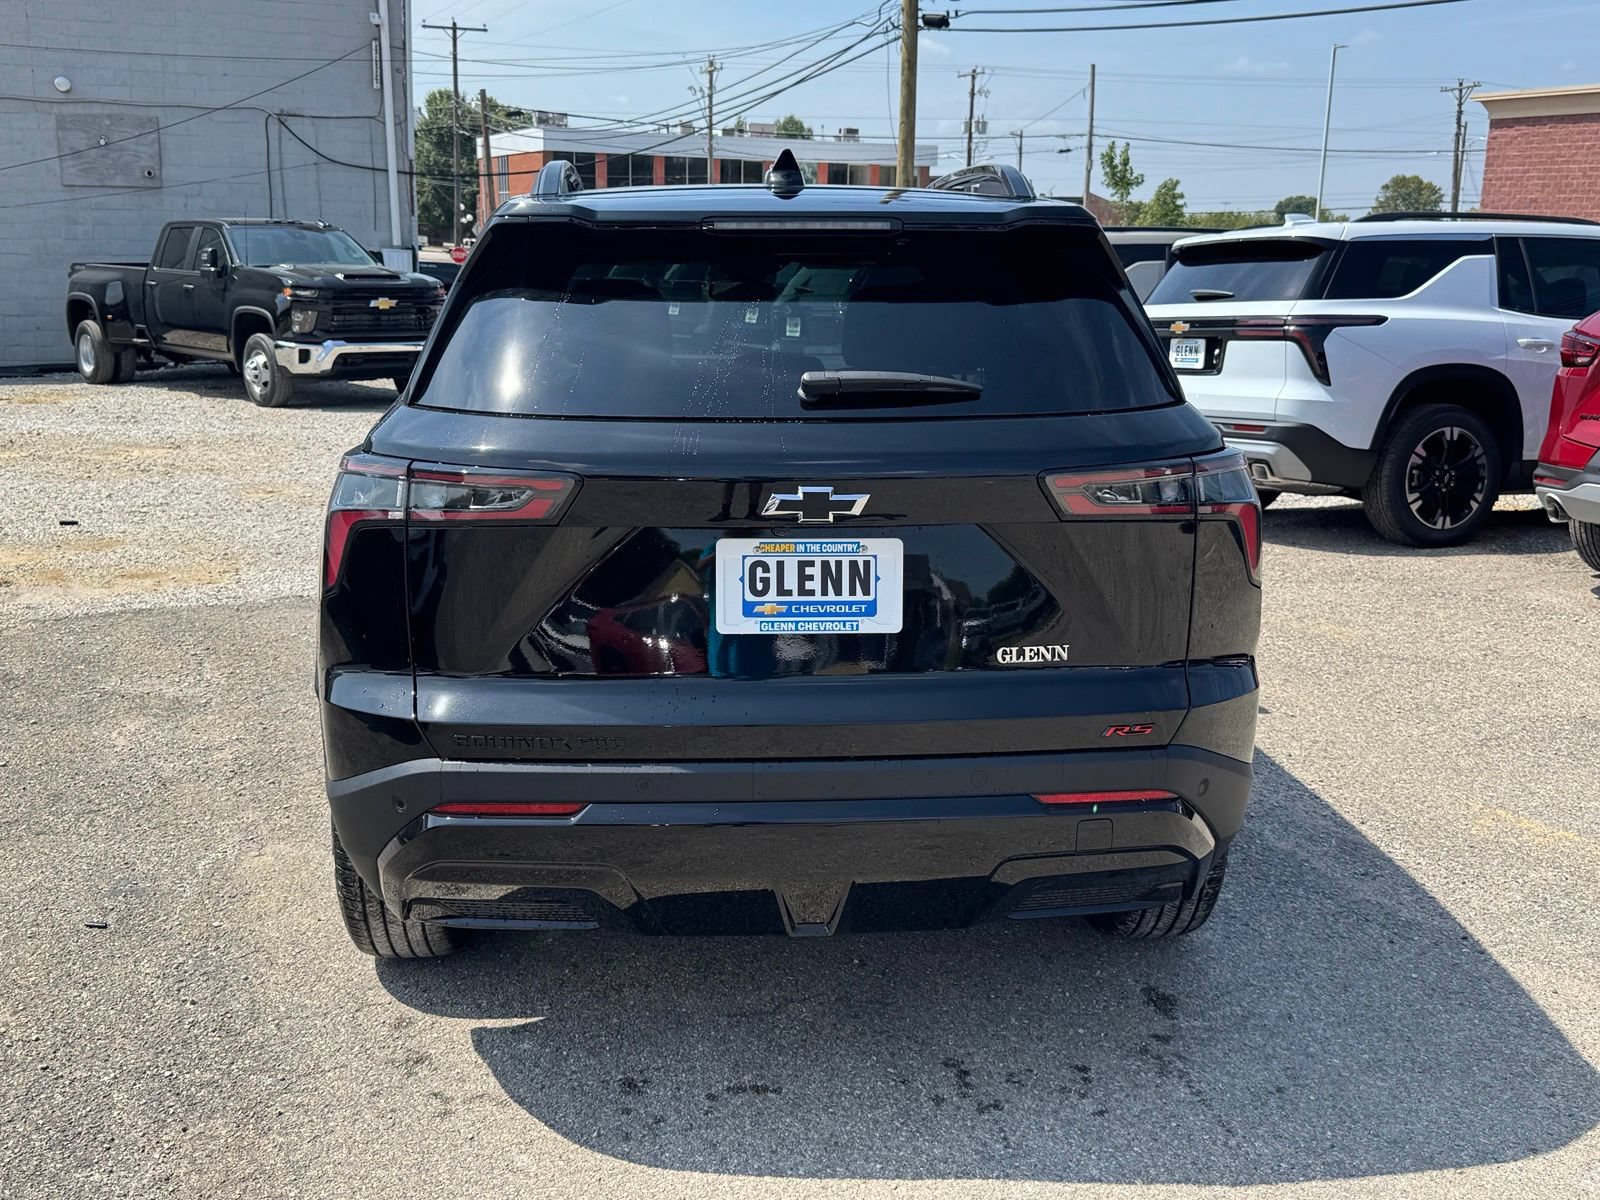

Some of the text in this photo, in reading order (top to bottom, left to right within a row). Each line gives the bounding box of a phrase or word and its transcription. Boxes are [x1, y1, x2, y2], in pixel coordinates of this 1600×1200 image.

[452, 251, 467, 259] STOP
[1175, 345, 1199, 357] GLENN
[760, 544, 795, 552] CHEAPER
[796, 544, 805, 552] IN
[806, 544, 821, 552] THE
[749, 559, 871, 597] GLENN
[792, 604, 867, 613] CHEVROLET
[761, 622, 858, 631] GLENN CHEVROLET
[996, 644, 1070, 664] GLENN
[1102, 723, 1155, 737] RS
